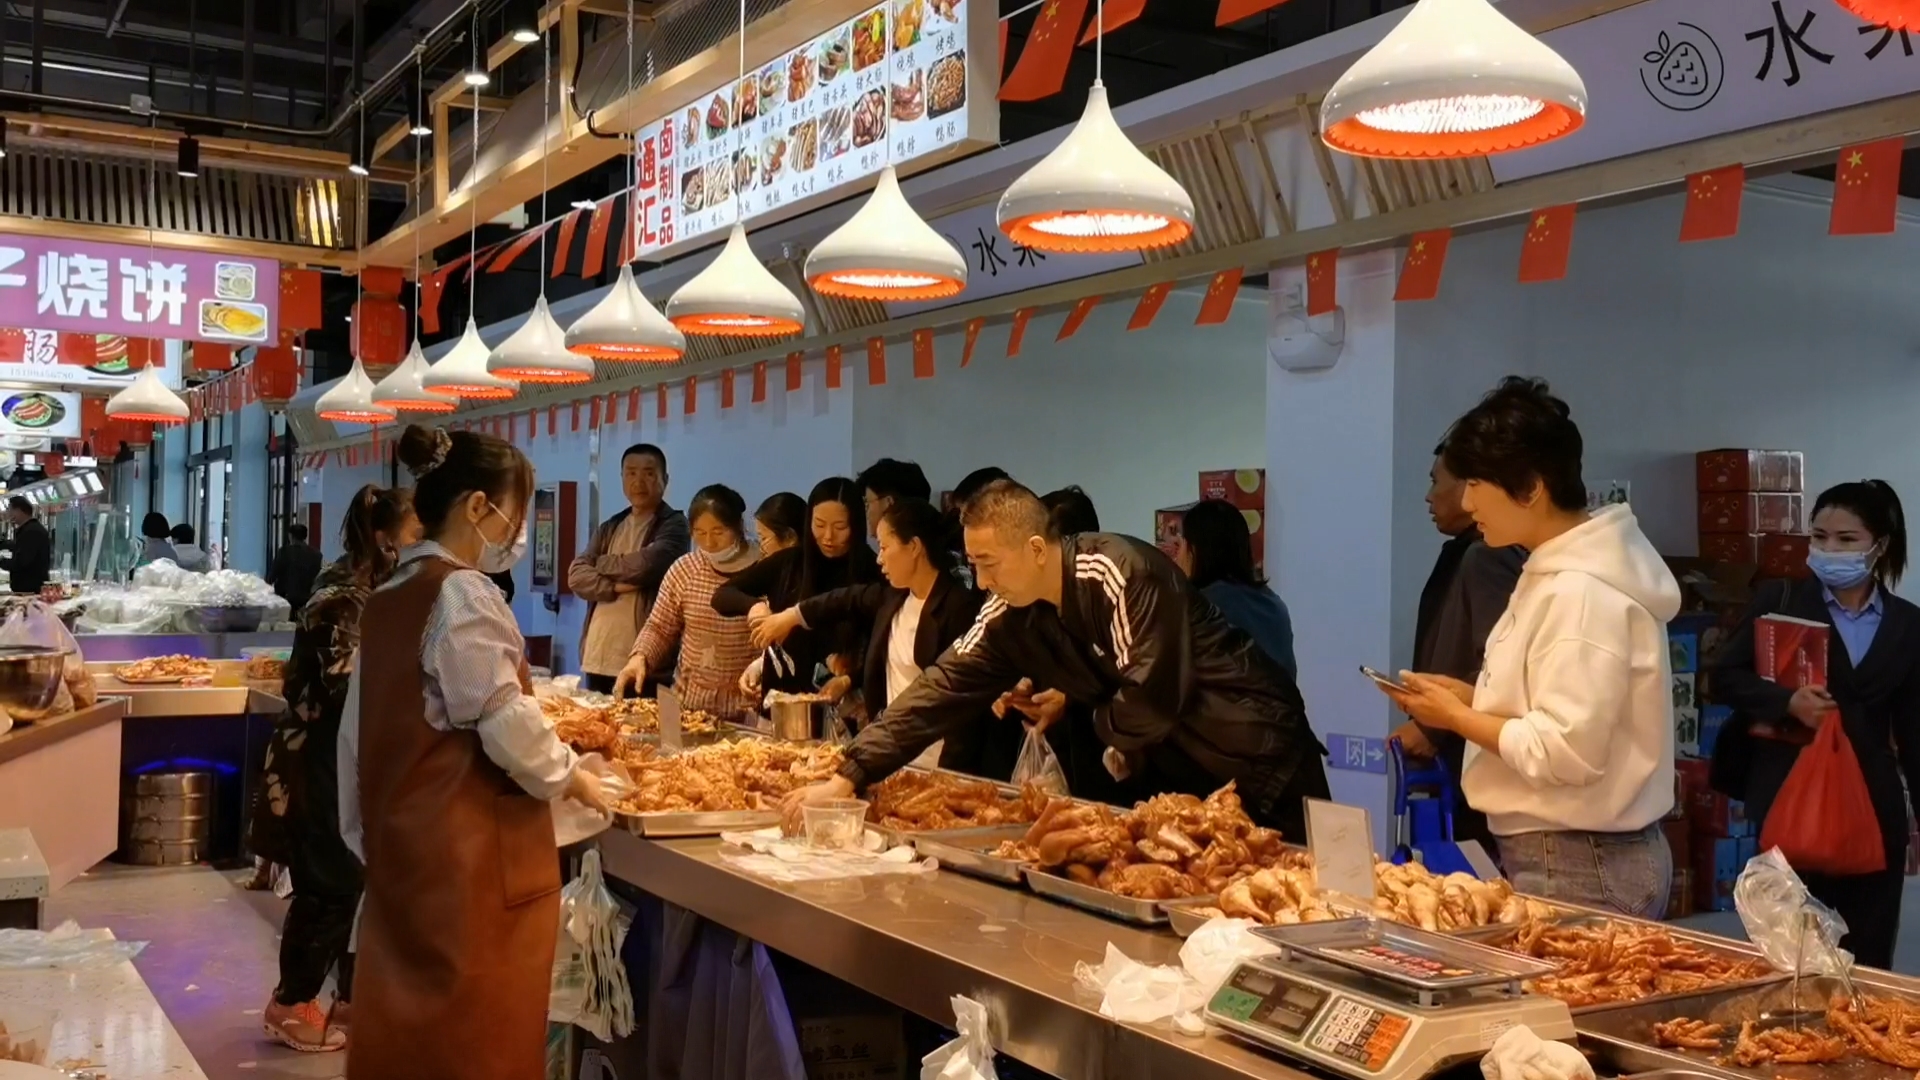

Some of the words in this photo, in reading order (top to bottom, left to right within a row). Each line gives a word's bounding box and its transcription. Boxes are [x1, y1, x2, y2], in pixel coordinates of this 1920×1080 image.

[637, 135, 656, 247] 通汇
[659, 118, 674, 246] 卤制品
[25, 330, 58, 365] 肠
